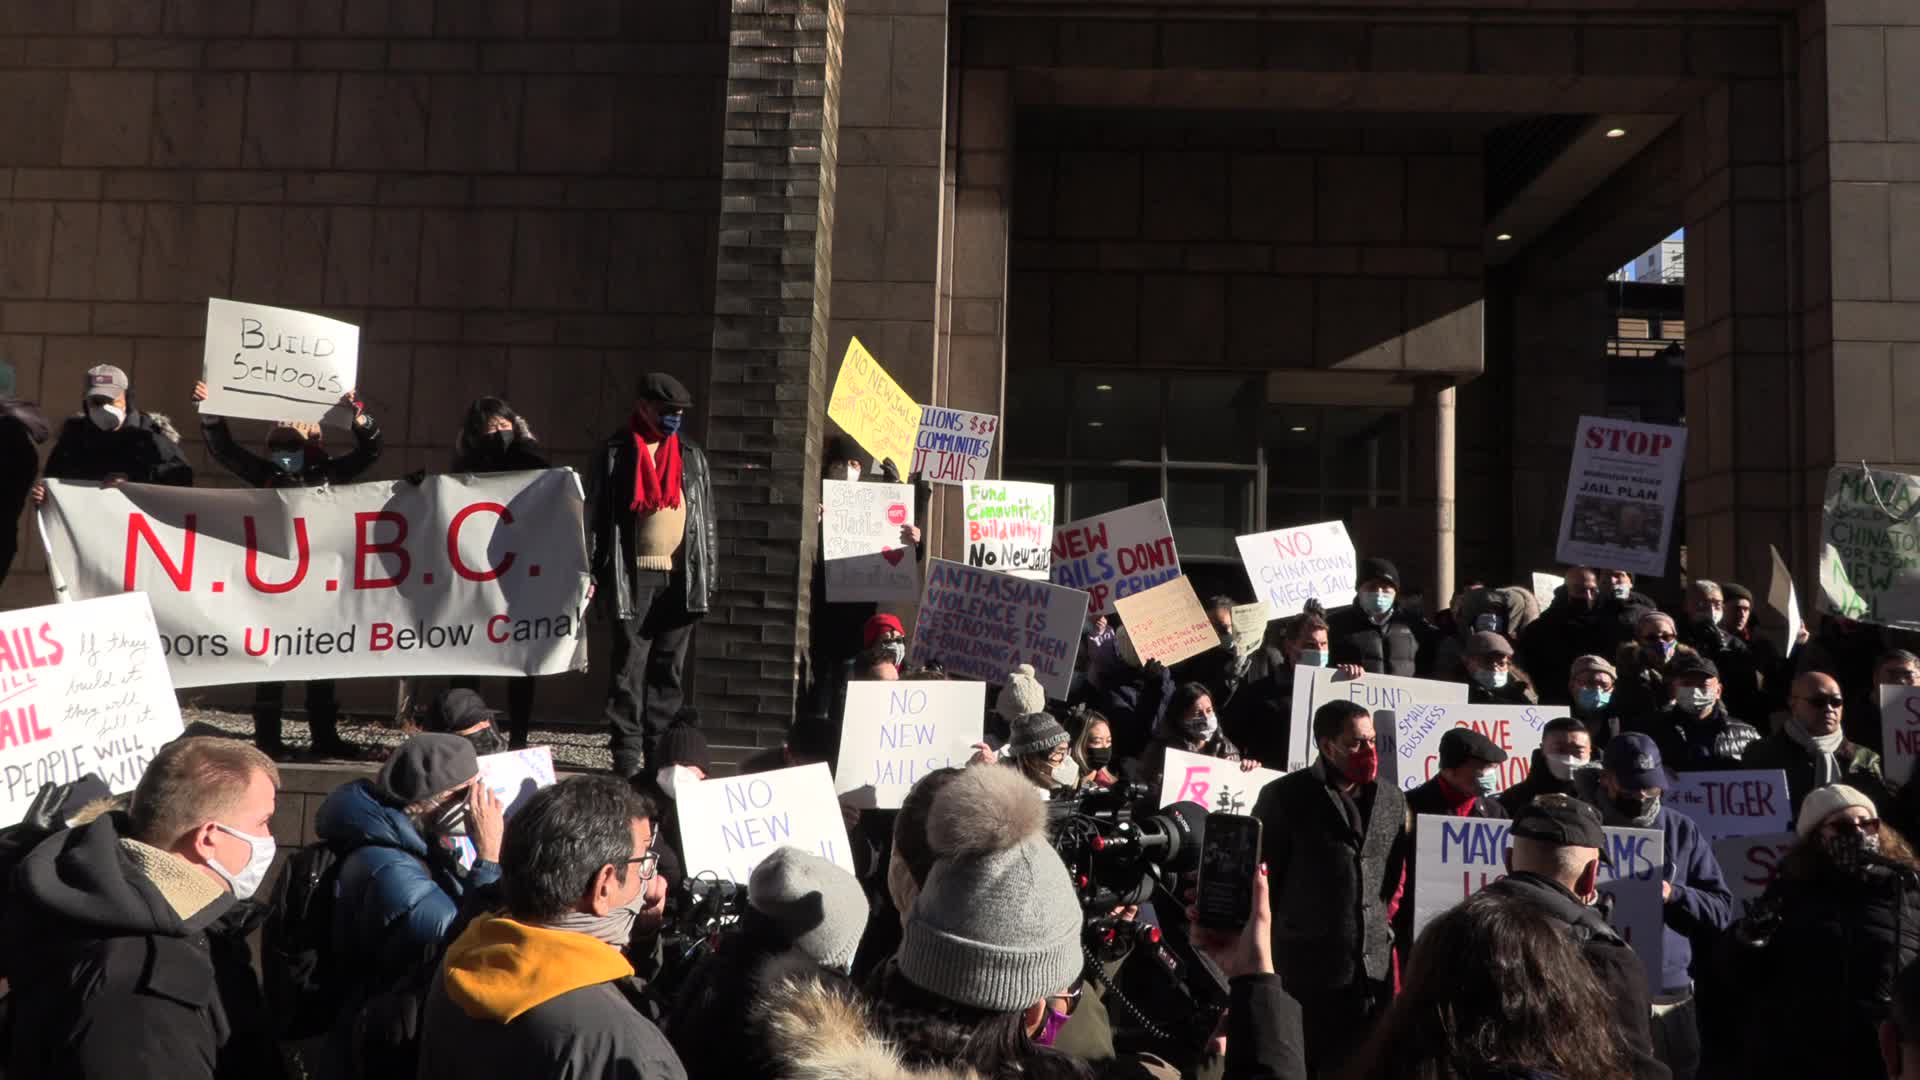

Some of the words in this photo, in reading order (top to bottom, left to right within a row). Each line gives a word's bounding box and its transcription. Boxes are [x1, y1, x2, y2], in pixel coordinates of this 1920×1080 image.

[920, 407, 964, 432] LLIONS
[917, 430, 990, 458] COMMUNITIES
[1584, 426, 1673, 457] STOP
[970, 485, 1006, 502] Fund
[1579, 481, 1614, 496] JAIL
[1617, 486, 1659, 501] PLAN
[969, 519, 1008, 541] Build
[1050, 522, 1108, 563] NEW
[1273, 531, 1312, 560] NO
[1830, 521, 1920, 552] CHINATO
[124, 501, 541, 594] N.U.B.C.
[969, 543, 997, 567] No
[1001, 543, 1029, 567] New
[1056, 552, 1115, 590] AILS
[1117, 536, 1175, 576] DONT
[1260, 552, 1352, 584] CHINATOWN
[1833, 559, 1893, 591] NEW
[929, 565, 1050, 608] ANTI-ASIAN
[1270, 580, 1321, 609] MEGA
[1323, 574, 1353, 594] JAIL
[927, 588, 1016, 625] VIOLENCE
[1025, 610, 1047, 632] IS
[244, 624, 356, 658] United
[369, 619, 474, 652] Below
[920, 607, 1021, 645] DESTROYING
[1025, 631, 1068, 659] THEN
[889, 688, 928, 715] NO
[94, 735, 144, 760] WILL
[879, 723, 936, 749] NEW
[1399, 705, 1446, 759] BUSINESS
[724, 778, 773, 814] NO
[1699, 781, 1776, 817] TIGER
[721, 811, 792, 853] NEW
